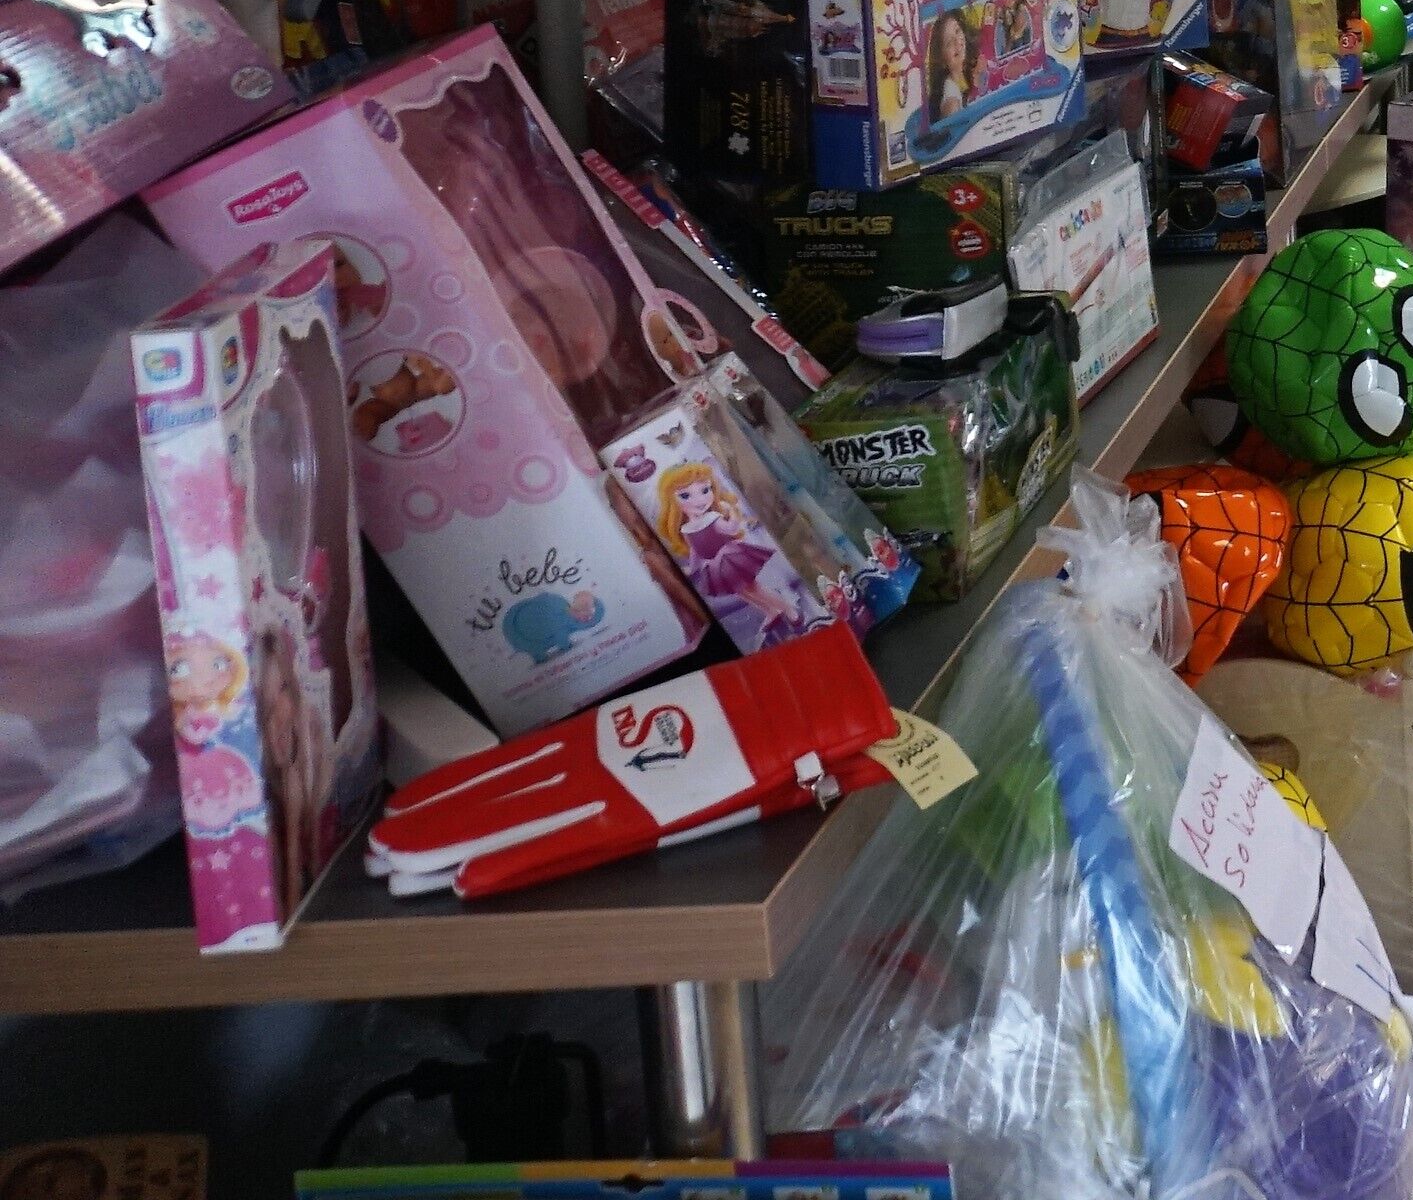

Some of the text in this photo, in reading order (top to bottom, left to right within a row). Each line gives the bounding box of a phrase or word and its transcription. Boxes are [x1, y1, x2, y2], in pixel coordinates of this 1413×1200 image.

[861, 120, 873, 189] Ravensburger
[954, 188, 978, 205] 3+
[773, 215, 894, 236] TRUCKS
[838, 465, 922, 488] RUCK
[498, 546, 584, 596] bebé
